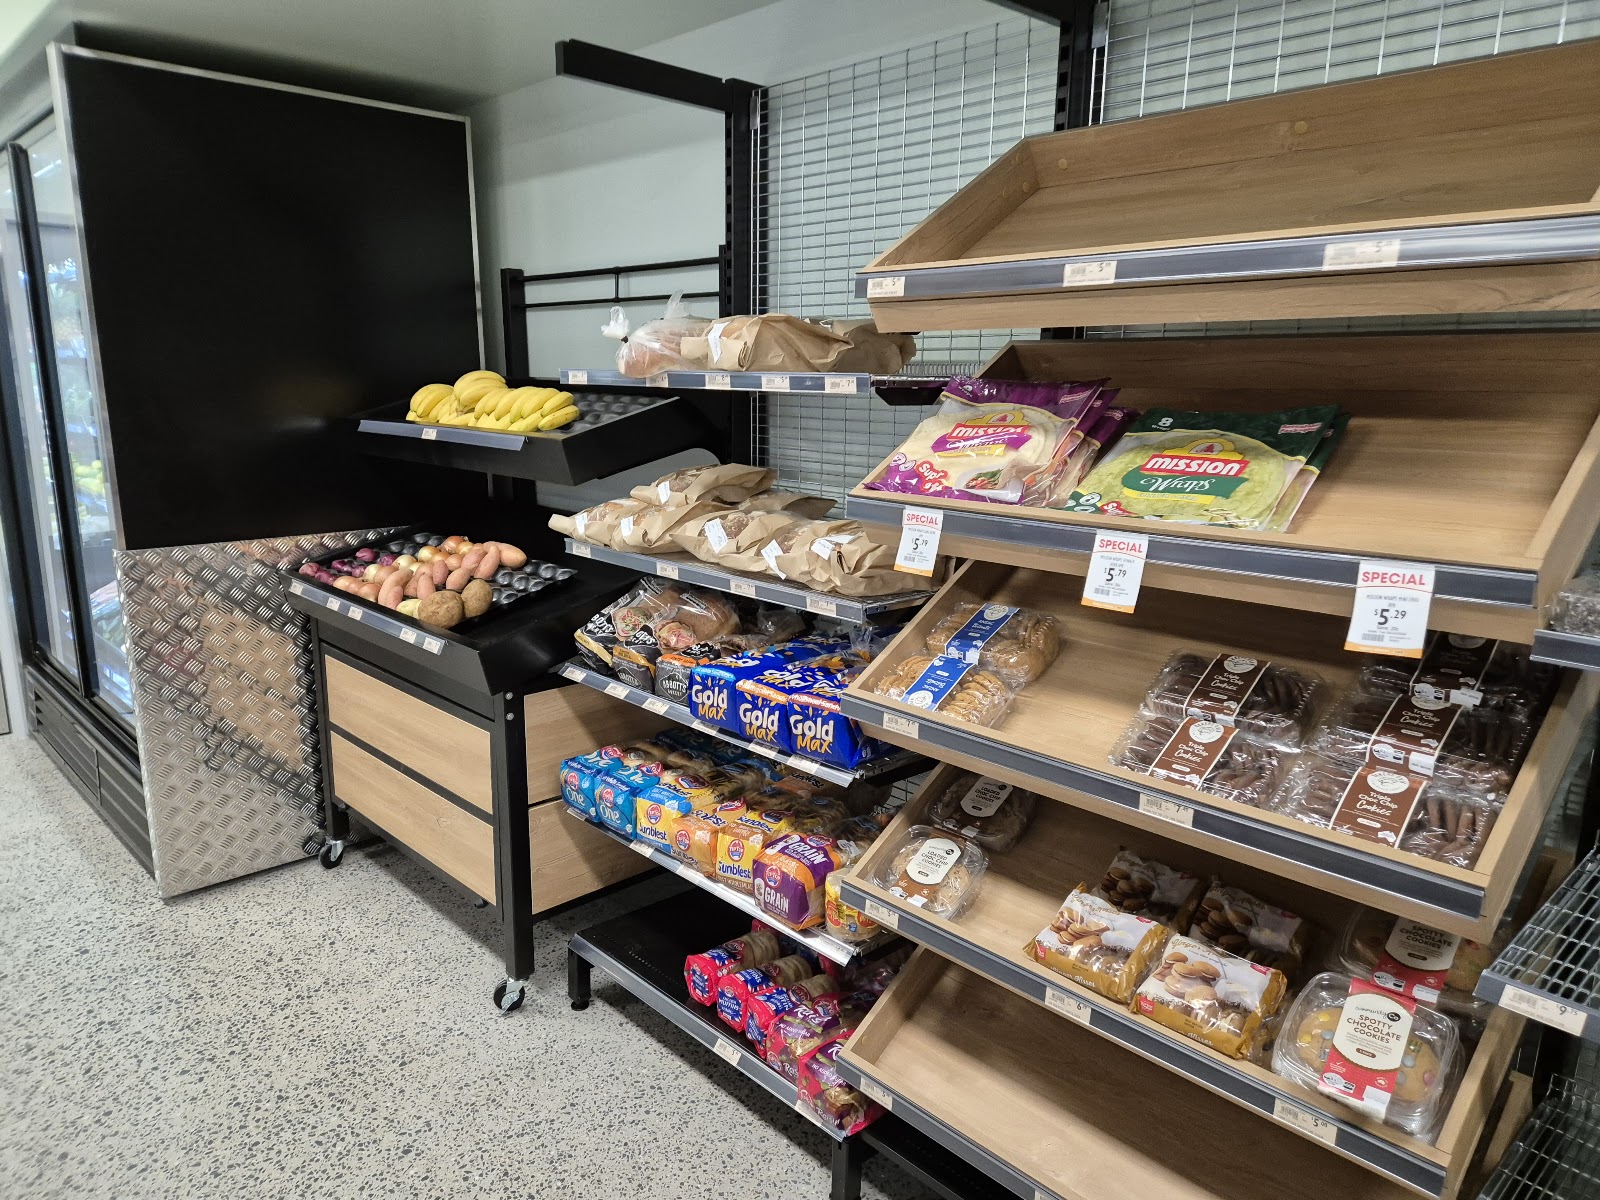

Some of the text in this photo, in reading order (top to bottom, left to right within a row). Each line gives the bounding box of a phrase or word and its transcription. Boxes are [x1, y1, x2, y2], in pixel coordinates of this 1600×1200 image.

[1158, 417, 1174, 427] 8
[1145, 456, 1243, 476] MISSION
[906, 513, 939, 526] SPECIAL
[1099, 538, 1143, 553] SPECIAL
[1362, 571, 1426, 586] SPECIAL
[1374, 608, 1407, 625] $5.29
[691, 685, 728, 709] Gold
[698, 704, 727, 720] Max
[739, 702, 780, 734] Gold
[745, 724, 776, 742] Max
[789, 715, 834, 743] Gold
[796, 734, 833, 754] Max
[1370, 791, 1391, 802] Triple
[1356, 799, 1393, 816] Cookies
[921, 852, 936, 861] CHOC
[1400, 927, 1453, 947] CHOCOLATE
[1406, 935, 1441, 949] COOKIES
[1347, 1017, 1401, 1041] CHOCOLATE
[1359, 1015, 1393, 1030] SPOTTY
[1353, 1027, 1390, 1043] COOKIES
